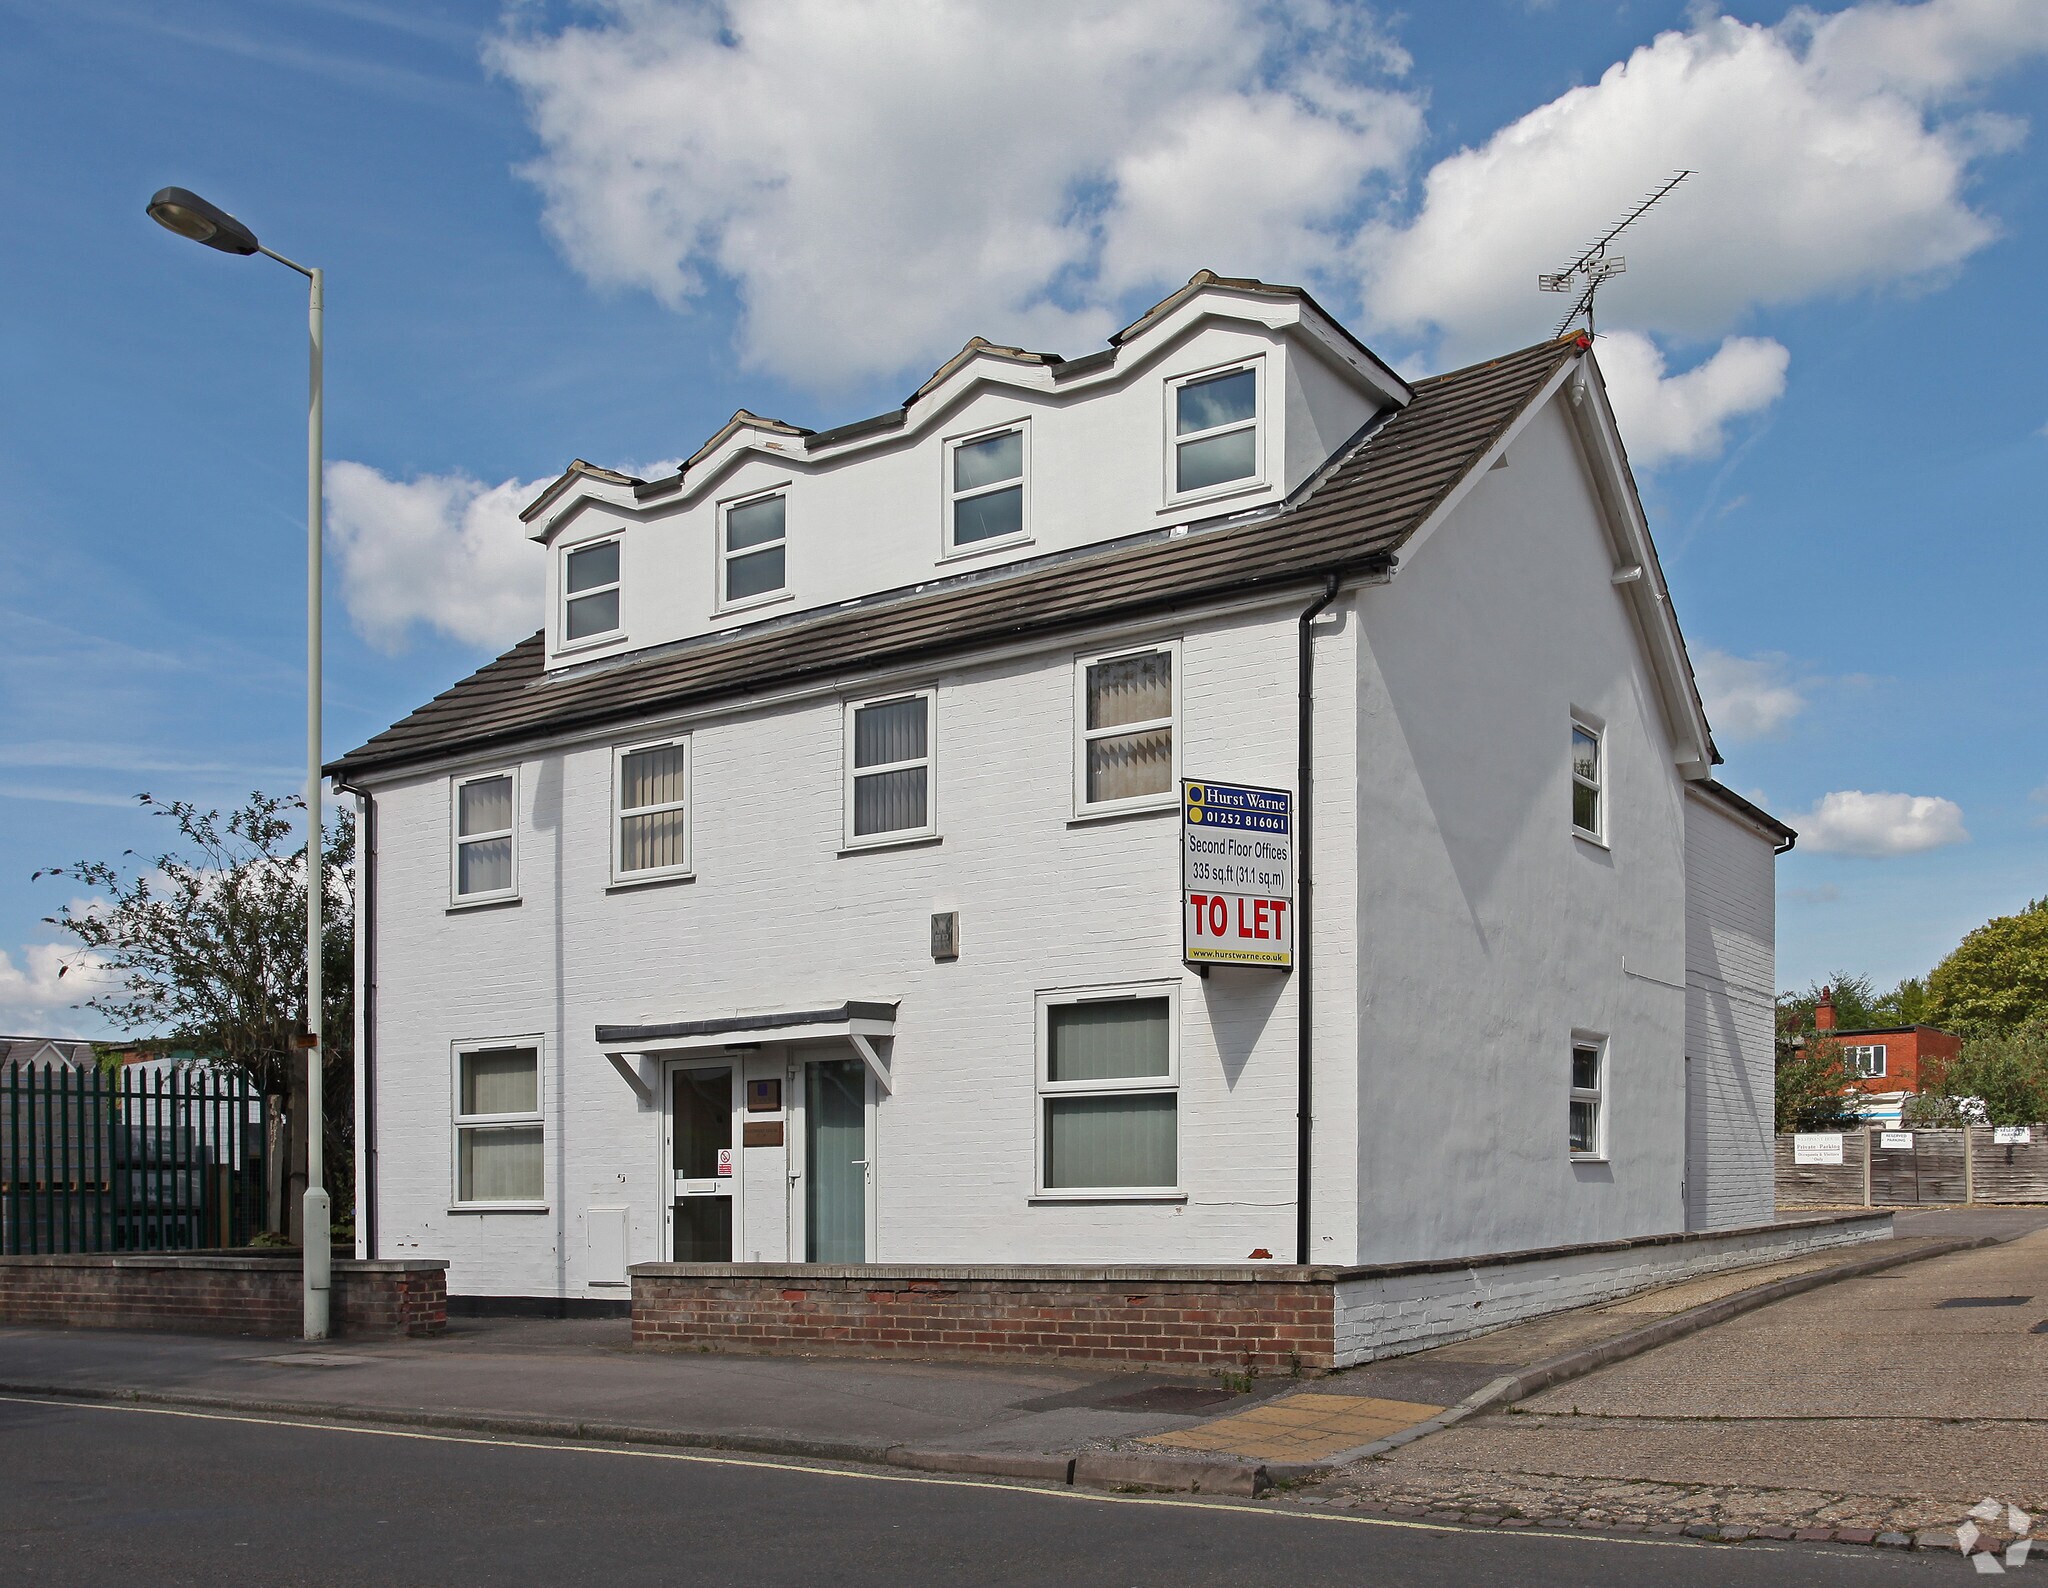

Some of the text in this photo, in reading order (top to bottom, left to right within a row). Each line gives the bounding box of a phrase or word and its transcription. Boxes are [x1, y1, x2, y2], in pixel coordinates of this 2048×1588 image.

[1206, 788, 1286, 811] Hurst Warne
[1206, 811, 1284, 830] 01252 816061
[1189, 835, 1288, 861] Second Floor Offices
[1193, 862, 1285, 890] 335 sq.ft (31.1 sq.m)
[1190, 894, 1287, 940] TO LET
[1193, 950, 1283, 961] www.hurstwarne.co.uk
